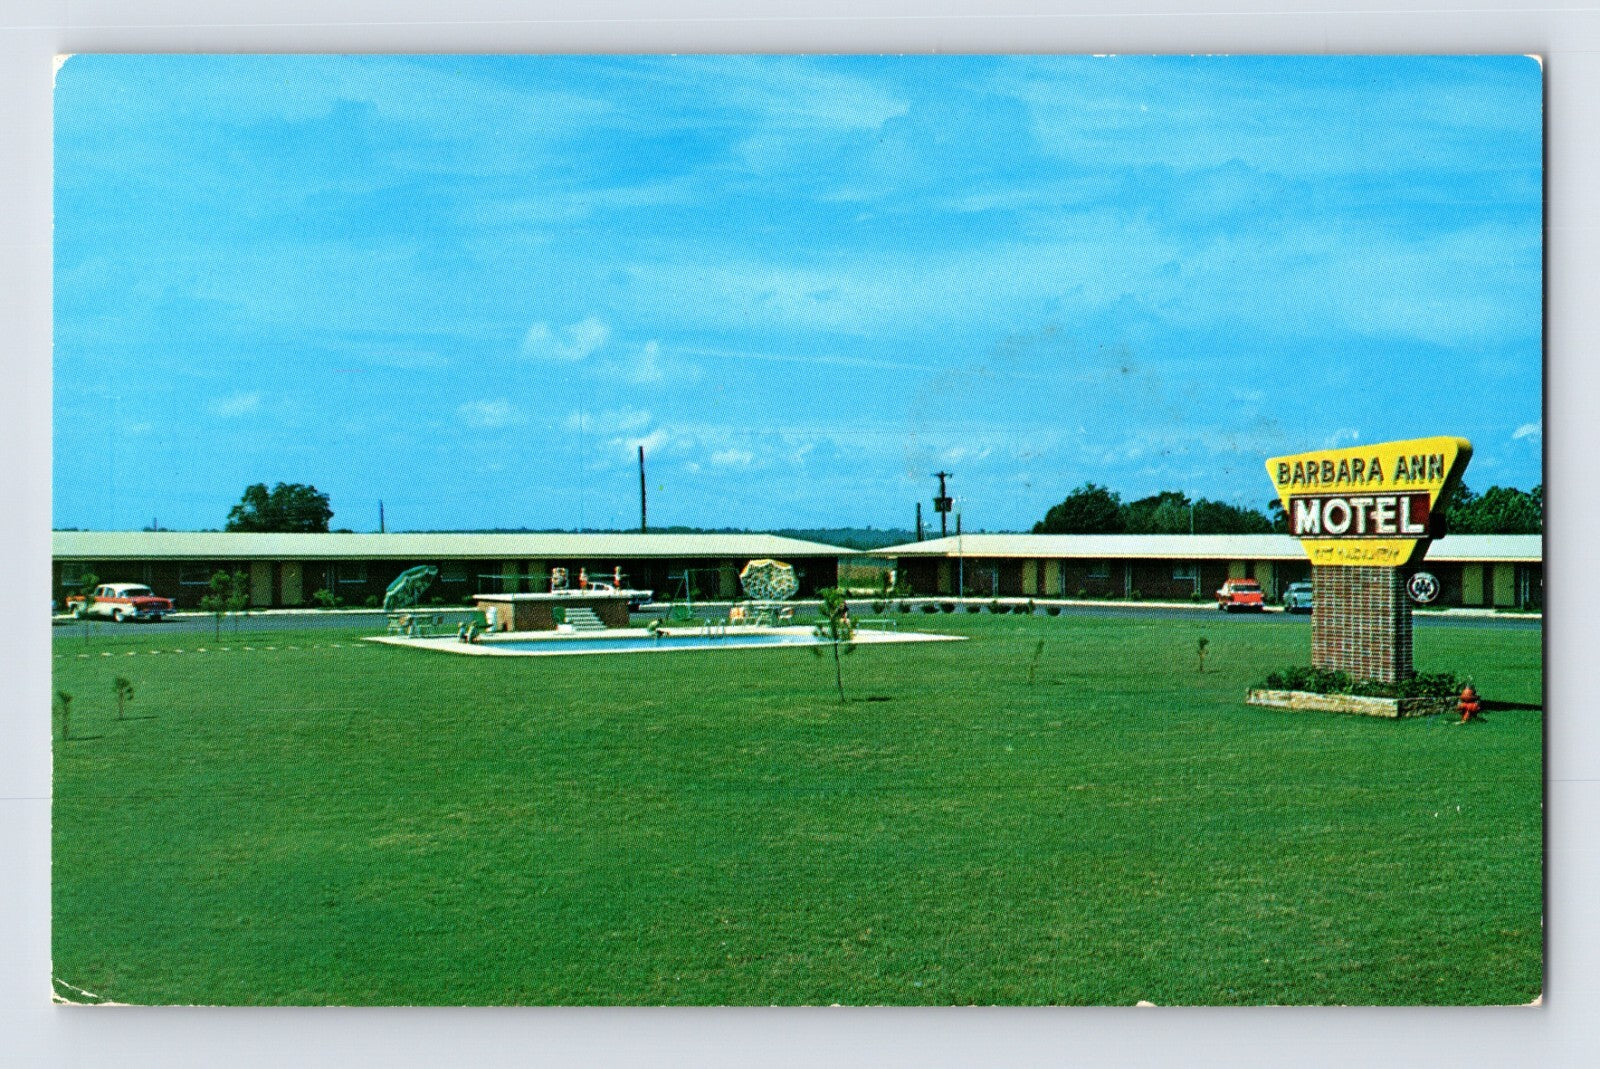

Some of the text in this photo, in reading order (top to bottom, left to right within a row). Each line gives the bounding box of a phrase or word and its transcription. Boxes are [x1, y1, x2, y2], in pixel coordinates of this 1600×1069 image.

[1276, 453, 1445, 486] BARBARA ANN
[1294, 496, 1425, 535] MOTEL
